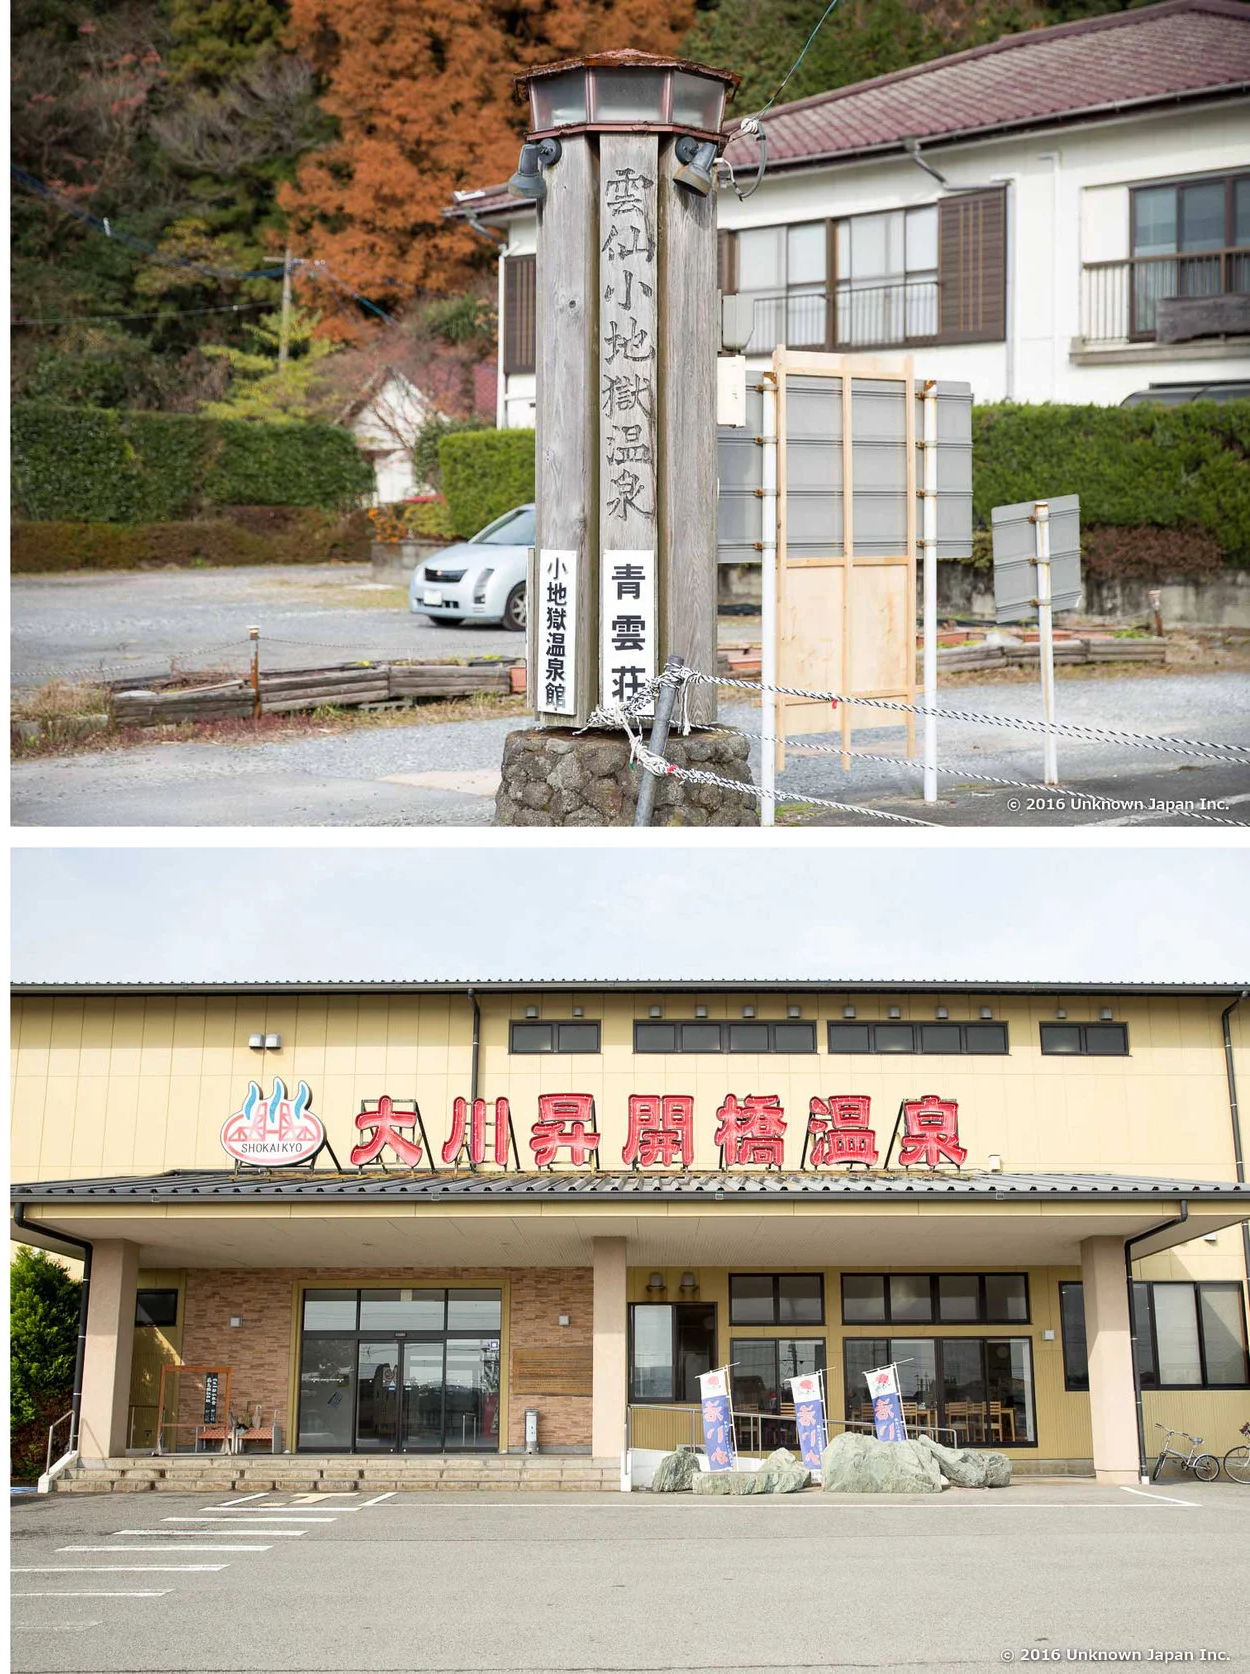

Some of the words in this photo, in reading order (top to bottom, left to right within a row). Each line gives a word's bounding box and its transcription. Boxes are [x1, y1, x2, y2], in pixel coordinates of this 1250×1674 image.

[602, 167, 655, 522] 雲仙小地獄温泉
[546, 557, 569, 709] 小地獄温泉館
[611, 563, 646, 703] 青雲荘
[241, 1142, 303, 1154] SHOKAIKYO
[350, 1092, 968, 1168] 大川昇開橋温泉
